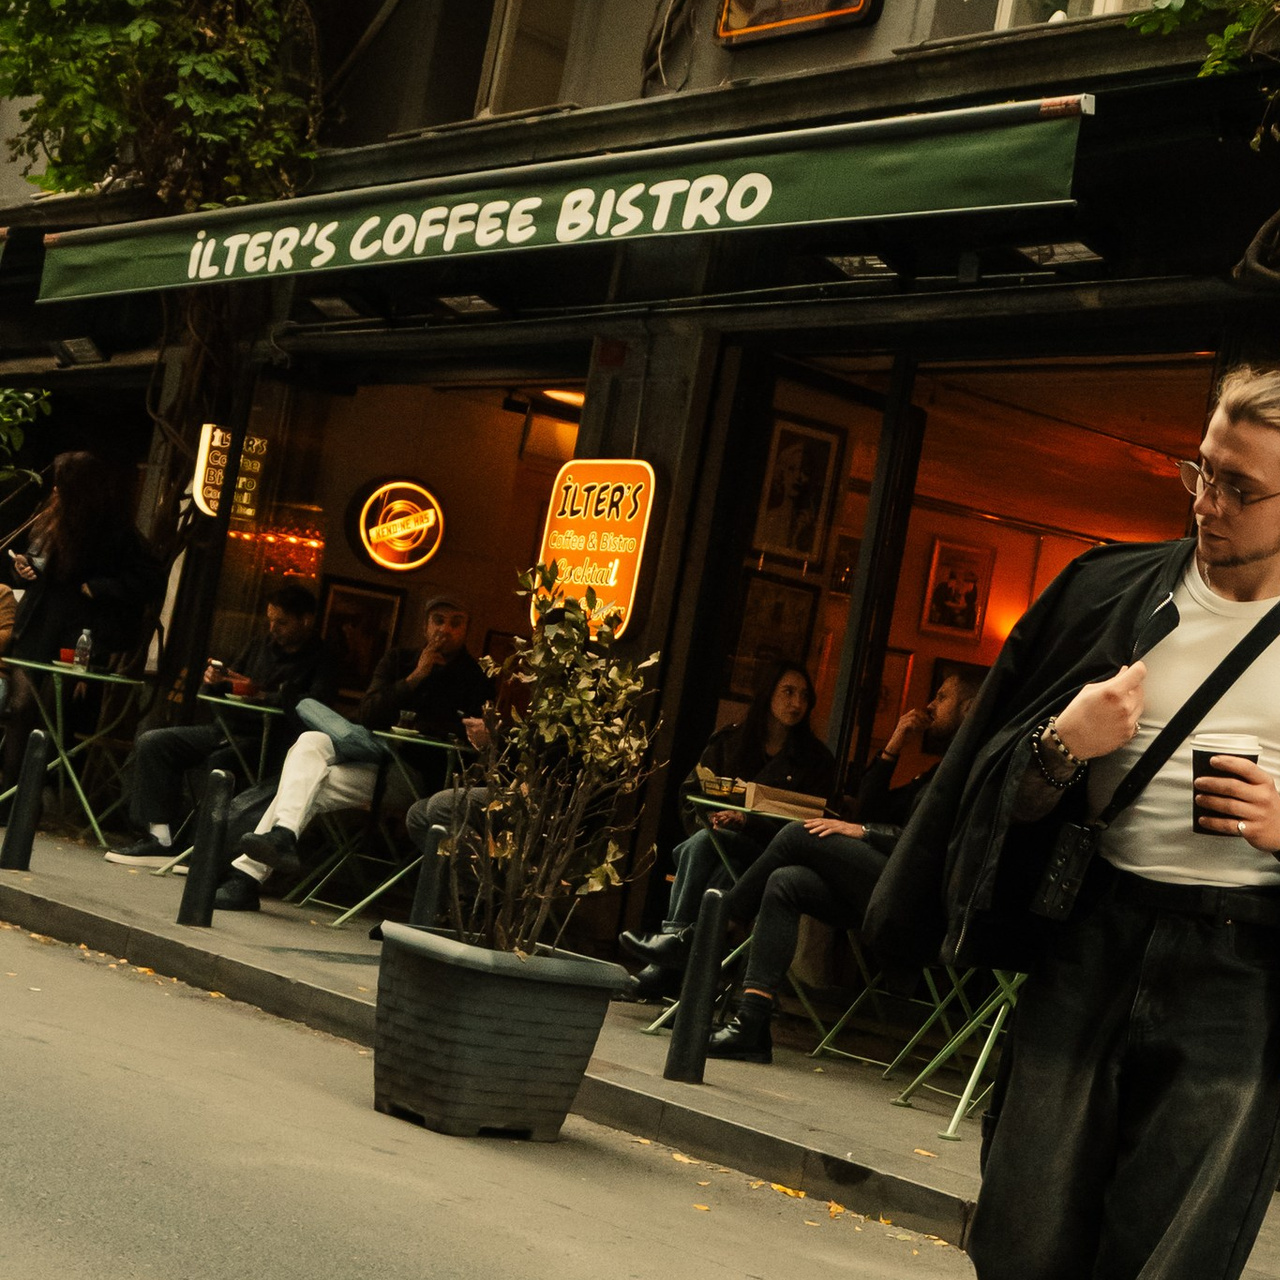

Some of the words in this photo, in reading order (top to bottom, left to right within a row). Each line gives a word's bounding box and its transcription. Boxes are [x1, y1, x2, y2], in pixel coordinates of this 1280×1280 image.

[187, 229, 339, 280] İLTER'S
[349, 196, 544, 262] COFFEE
[556, 172, 774, 244] BISTRO
[556, 475, 645, 522] İLTER'S
[549, 530, 584, 551] Coffee
[587, 531, 597, 551] &
[600, 532, 636, 553] Bistro
[555, 557, 620, 587] Cocktail
